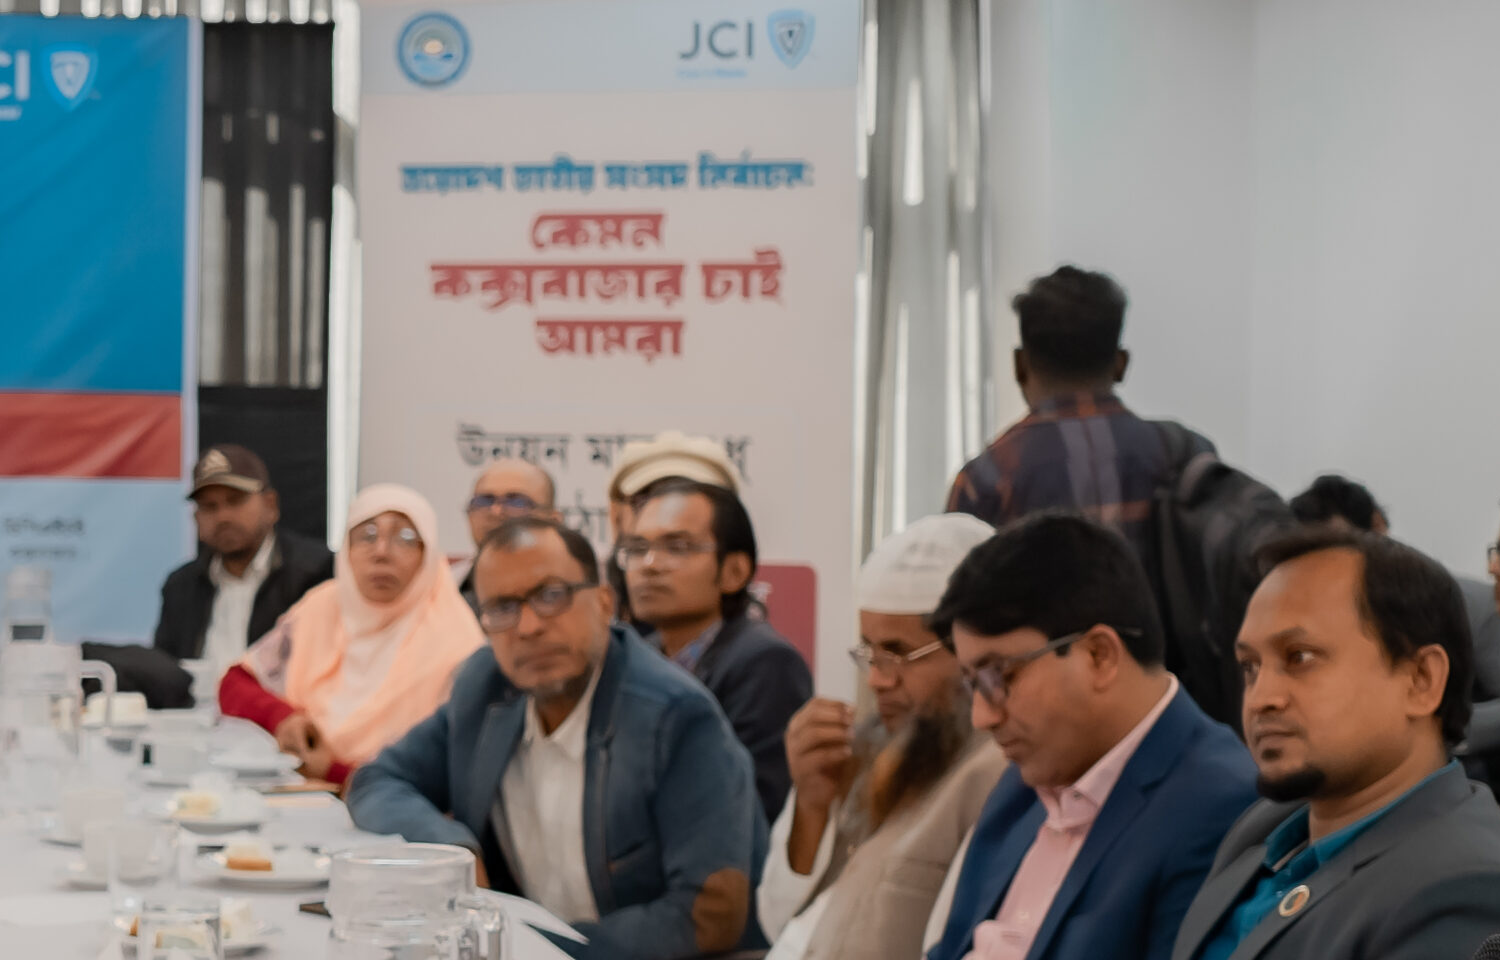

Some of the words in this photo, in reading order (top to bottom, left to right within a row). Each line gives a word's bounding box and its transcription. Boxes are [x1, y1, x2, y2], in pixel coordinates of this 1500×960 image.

[677, 21, 755, 60] JCI
[513, 154, 596, 194] জাতীয়
[604, 162, 690, 189] সংসদ
[531, 212, 666, 251] কেমন
[430, 263, 686, 311] কক্সবাজার
[698, 248, 784, 304] চাই
[535, 320, 686, 362] আমরা
